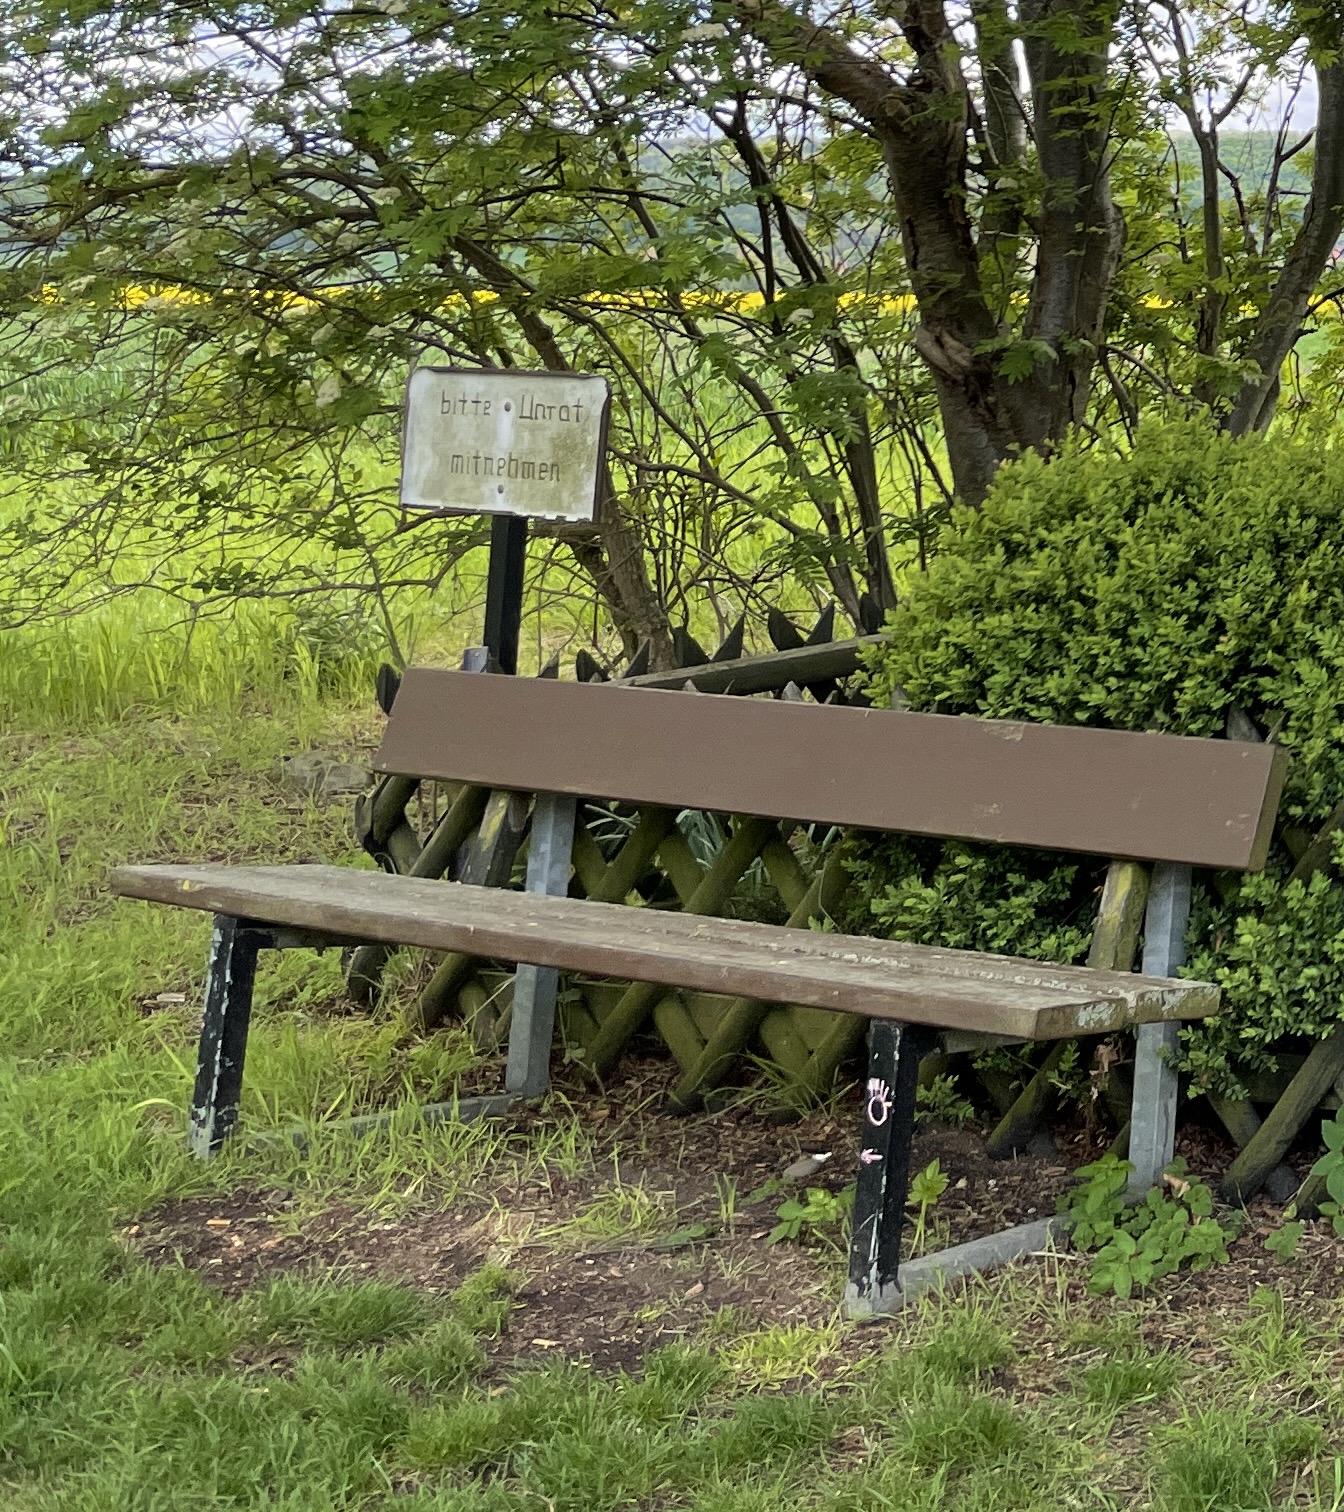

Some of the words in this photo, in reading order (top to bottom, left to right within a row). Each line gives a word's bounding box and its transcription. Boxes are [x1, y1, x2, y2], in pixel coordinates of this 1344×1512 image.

[440, 390, 492, 416] bitte
[518, 394, 584, 423] Unrat
[450, 449, 561, 482] mitnehmen
